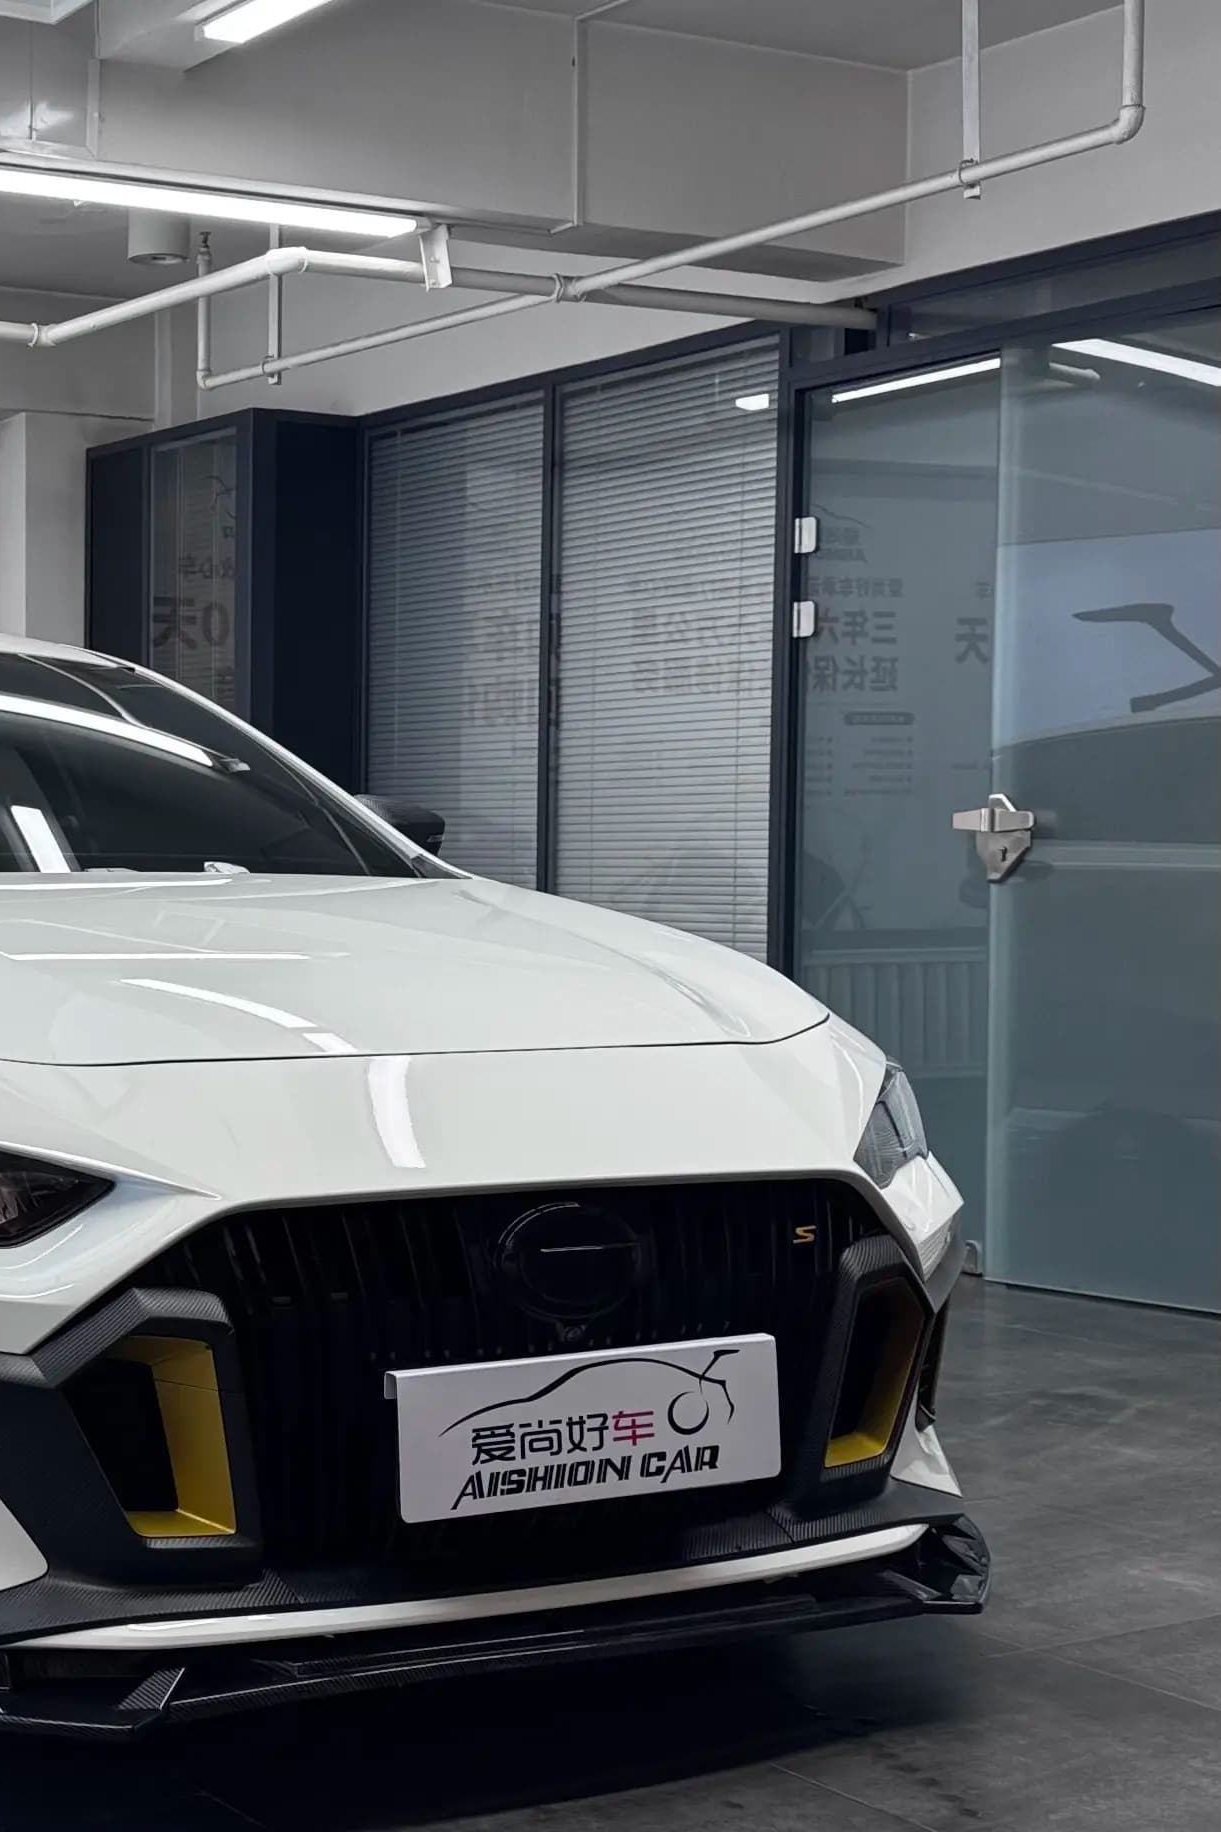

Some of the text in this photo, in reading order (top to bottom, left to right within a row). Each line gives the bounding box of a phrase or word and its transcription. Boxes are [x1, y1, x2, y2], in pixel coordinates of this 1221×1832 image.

[471, 1410, 655, 1466] 爱尚好车
[450, 1444, 720, 1511] AISHION CAR
